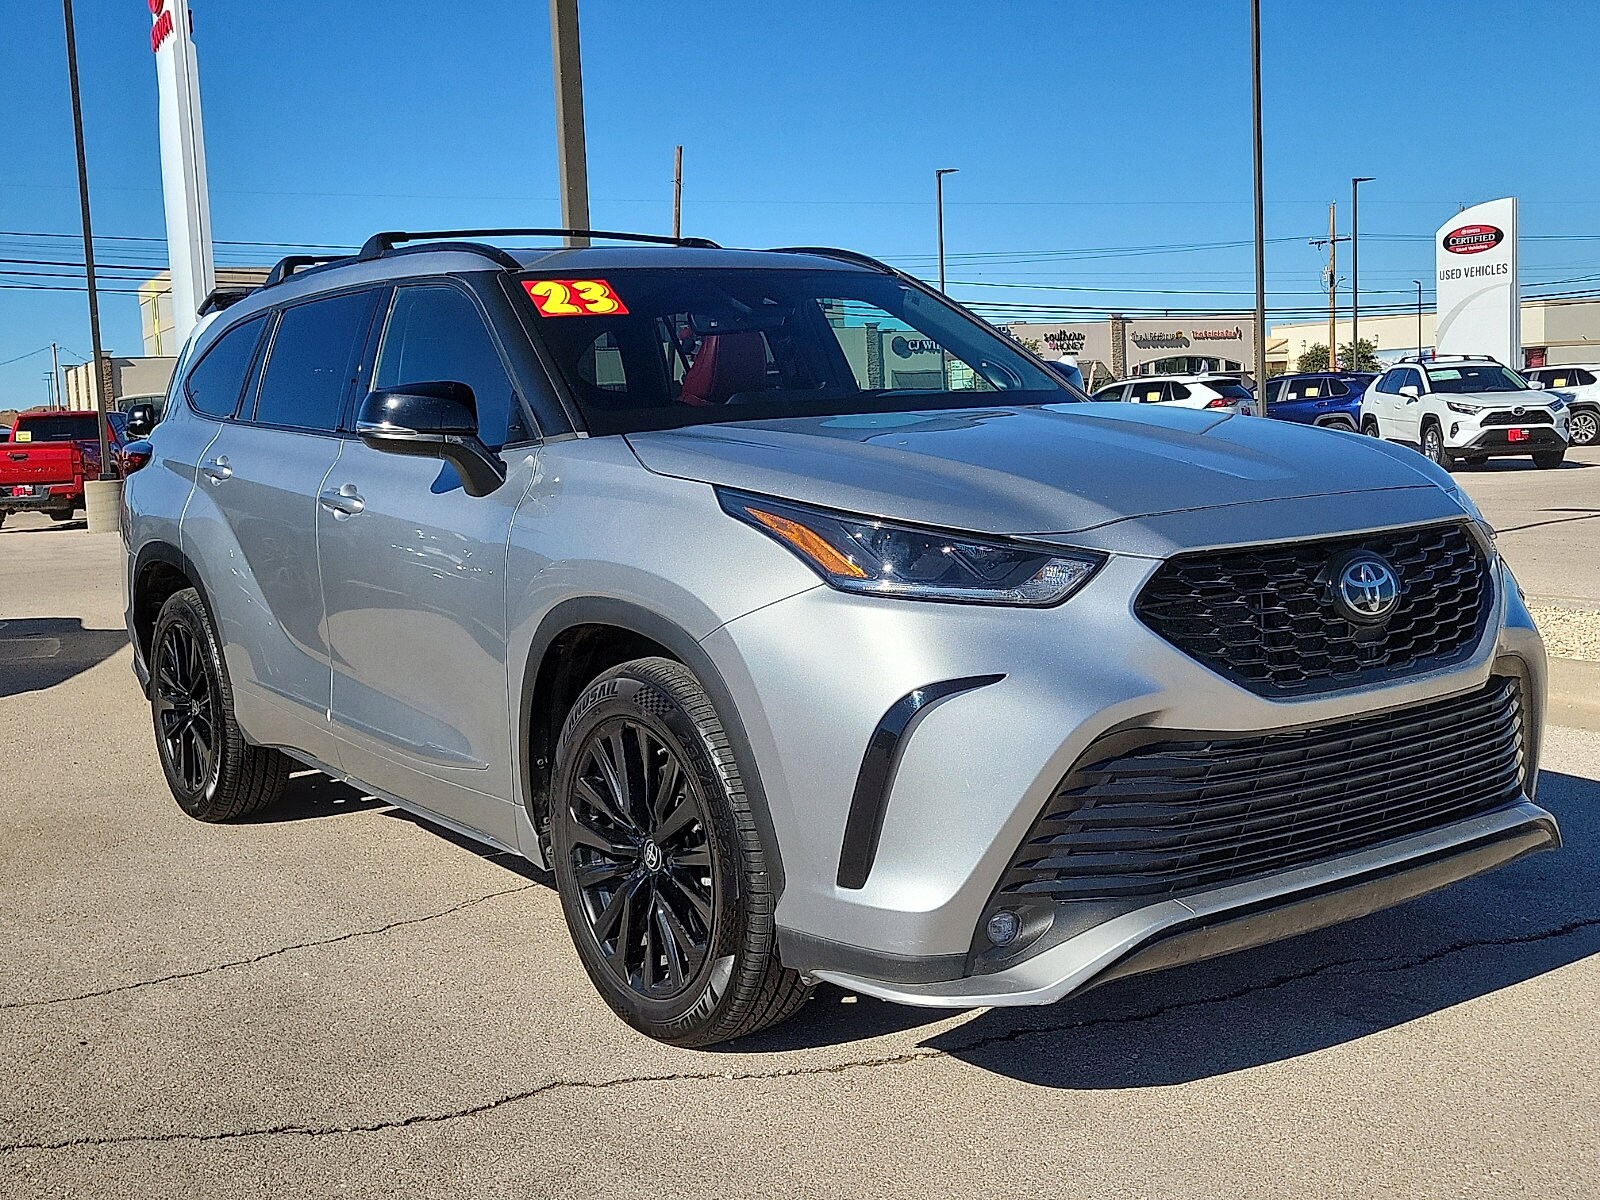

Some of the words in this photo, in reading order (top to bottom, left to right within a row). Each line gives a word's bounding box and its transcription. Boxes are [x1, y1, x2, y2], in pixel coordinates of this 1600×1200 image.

[1449, 233, 1495, 246] CERTIFIED
[1440, 268, 1461, 280] USED
[1464, 263, 1508, 278] VEHICLES
[530, 281, 619, 313] 23
[908, 340, 920, 350] CJ
